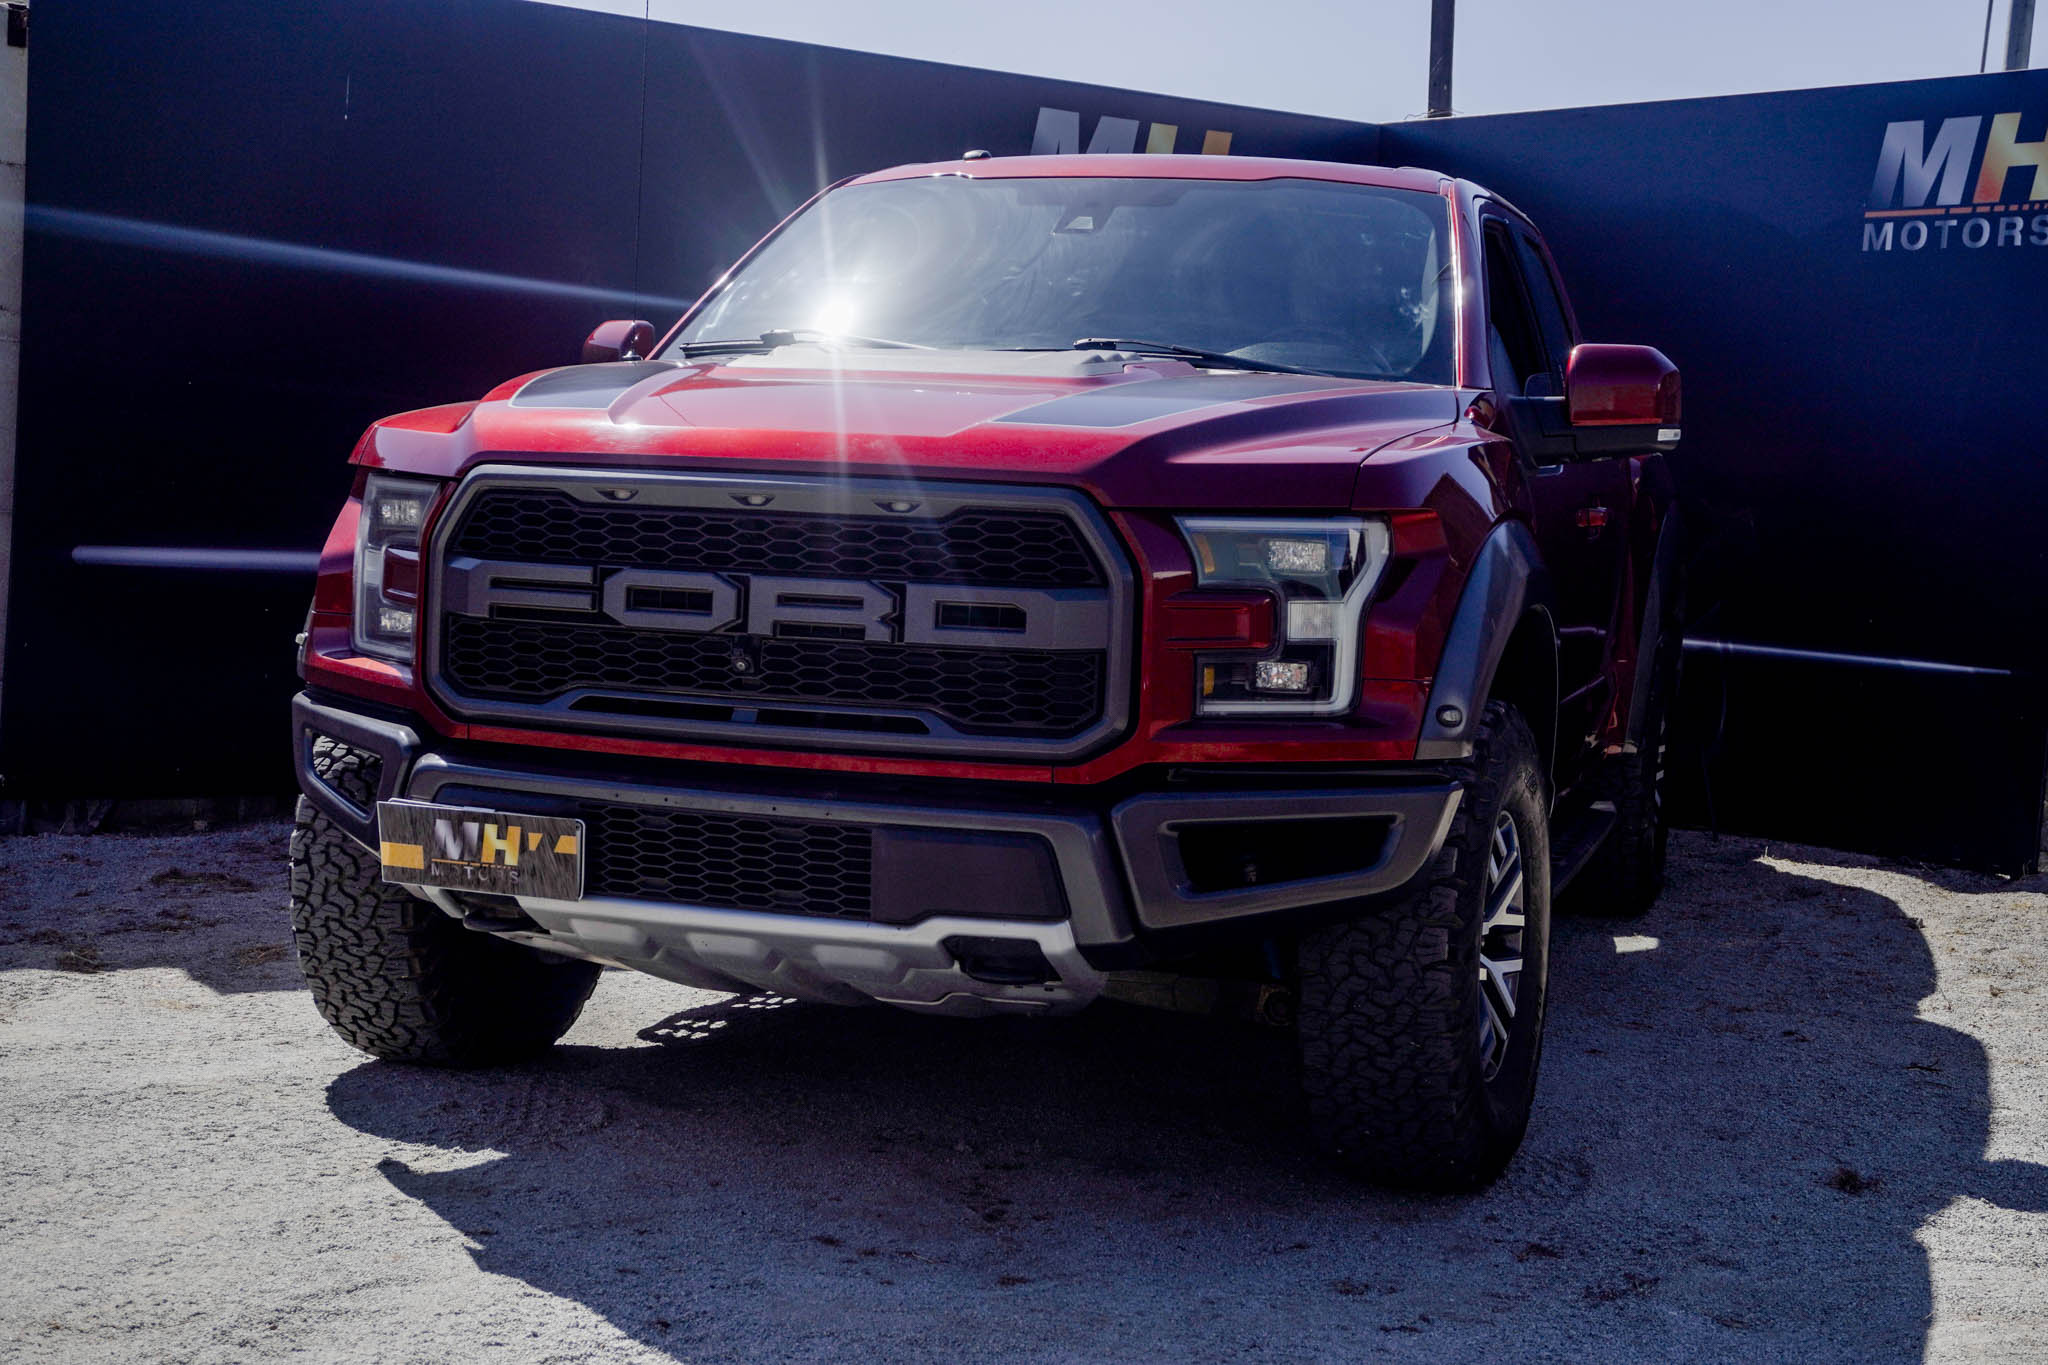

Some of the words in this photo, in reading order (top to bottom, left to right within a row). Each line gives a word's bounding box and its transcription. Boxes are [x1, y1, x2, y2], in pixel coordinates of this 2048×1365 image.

[1869, 112, 2048, 208] MH
[1862, 215, 2048, 251] MOTORS
[462, 558, 1070, 650] FORD
[431, 862, 521, 884] MTOS
